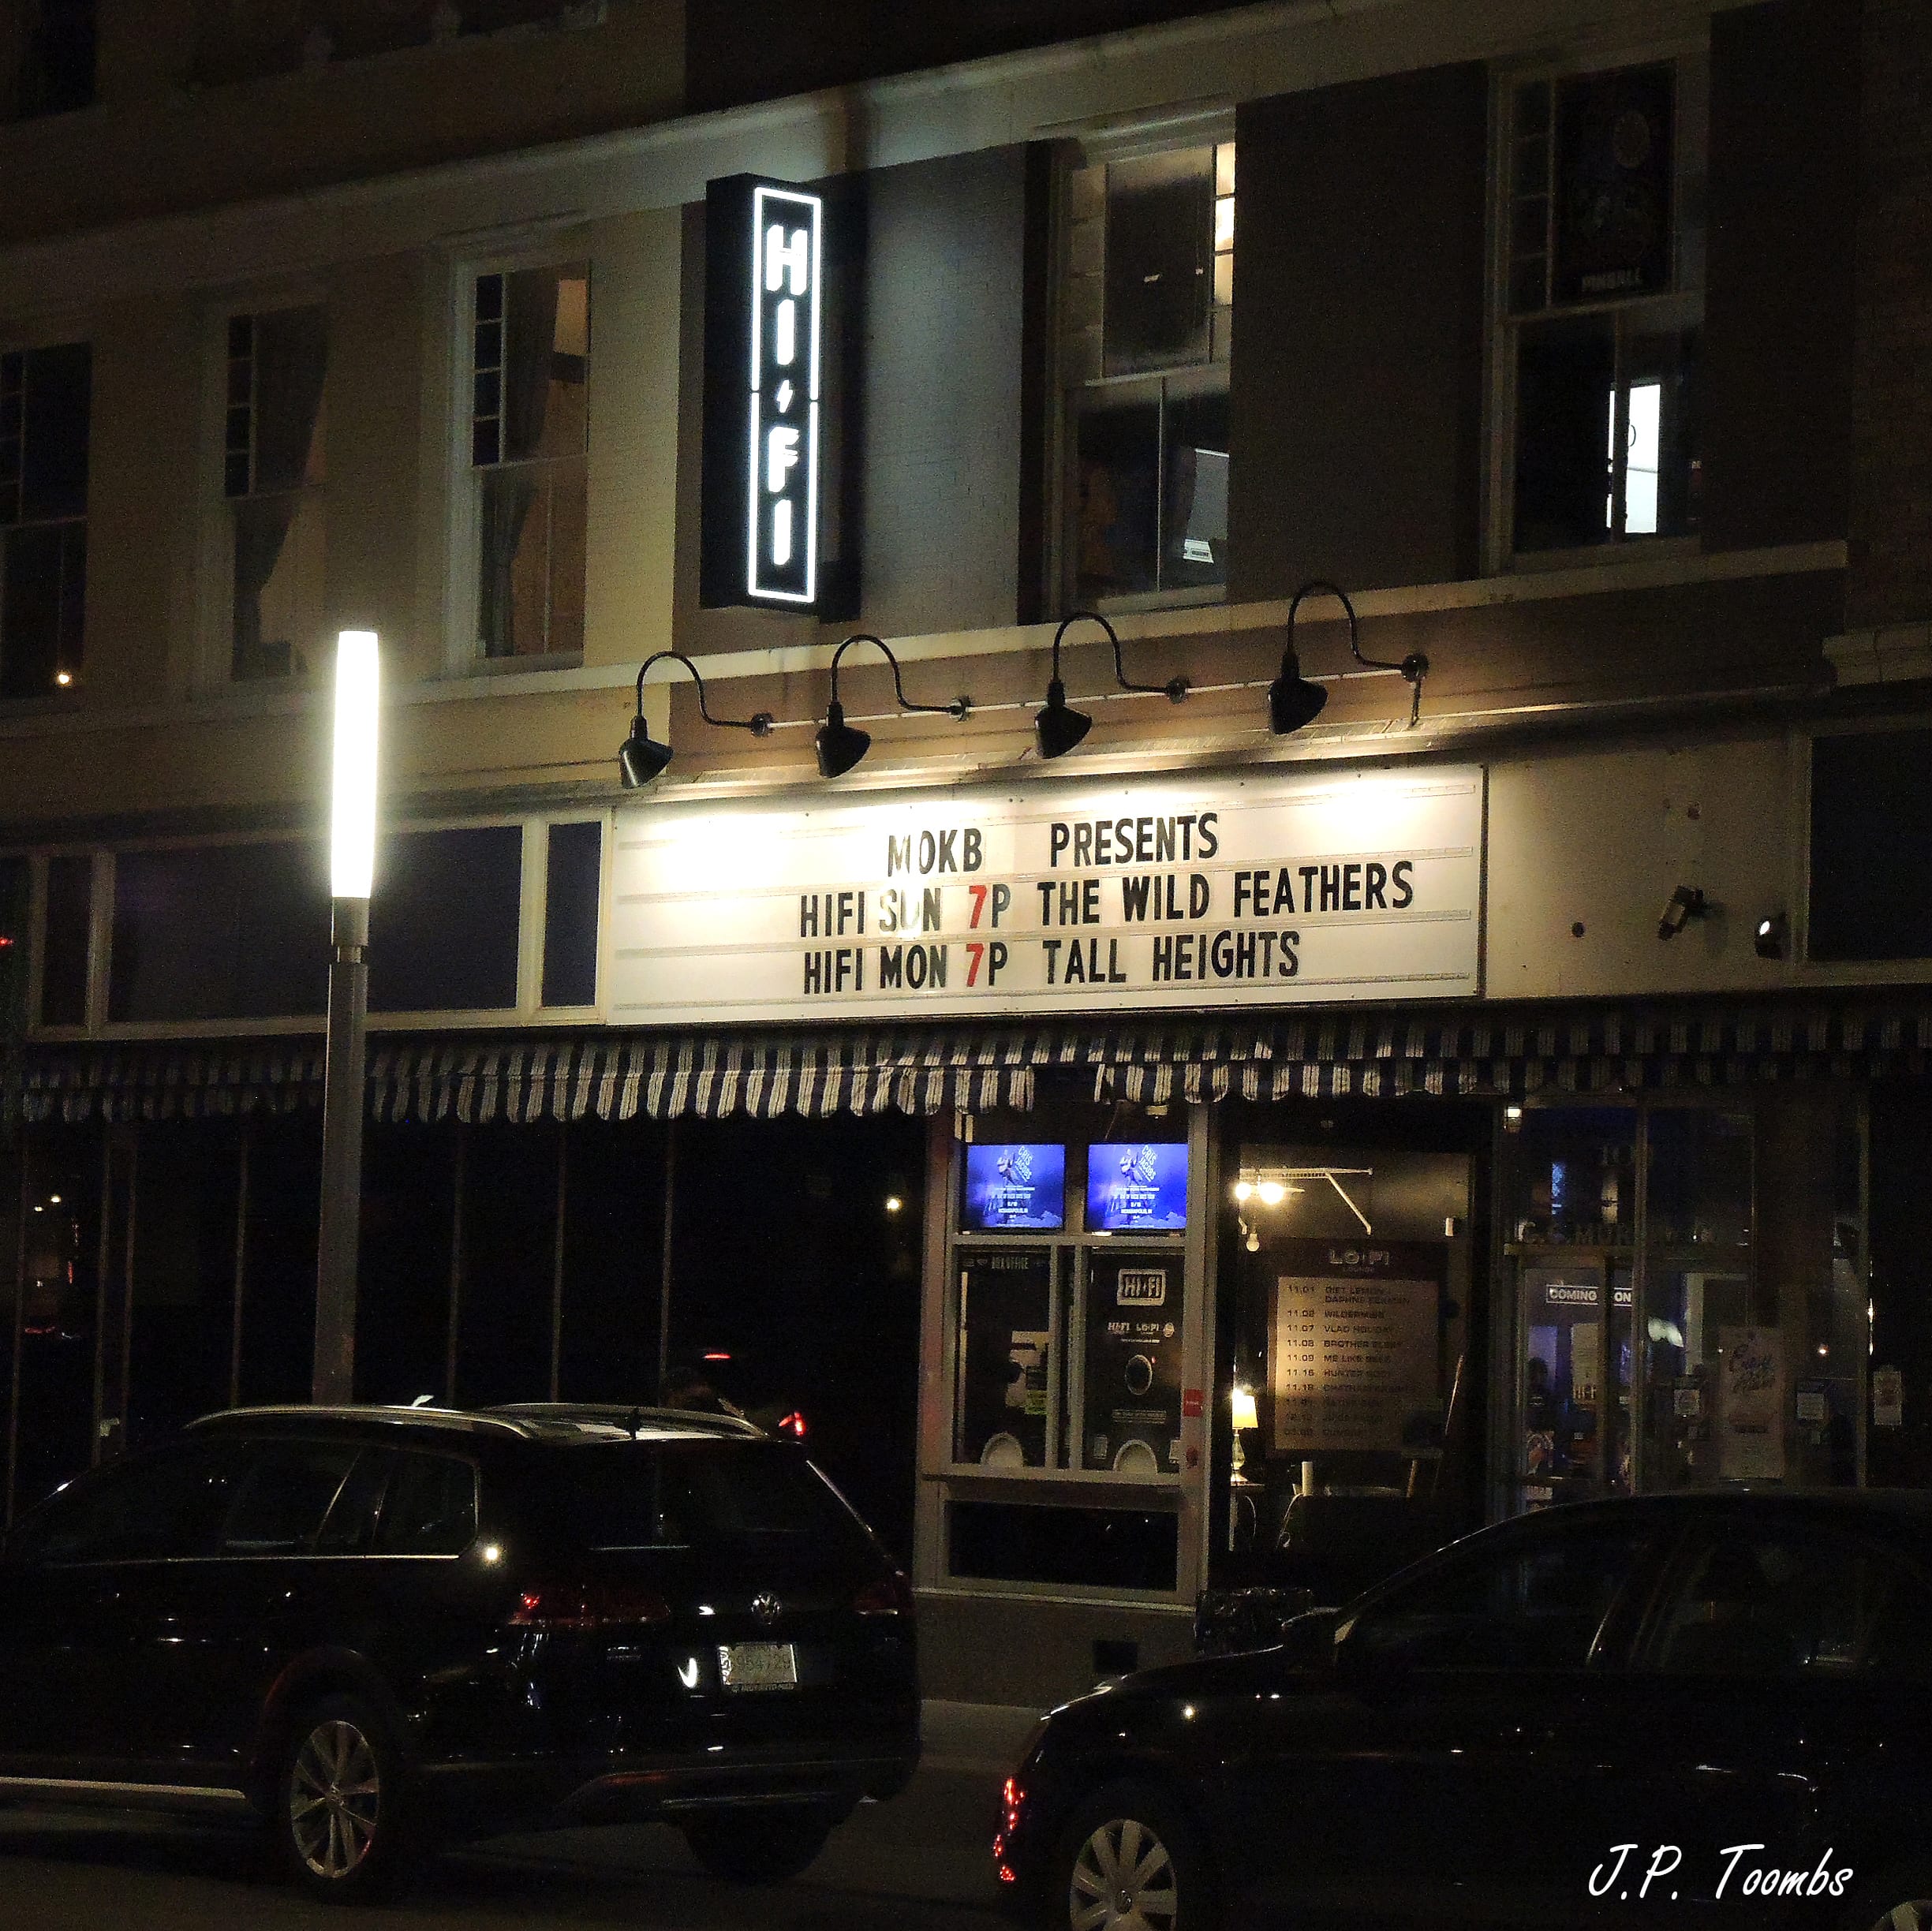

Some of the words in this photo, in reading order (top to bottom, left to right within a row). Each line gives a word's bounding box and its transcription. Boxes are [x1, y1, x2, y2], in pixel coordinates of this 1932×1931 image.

[888, 827, 983, 877] MOKB
[1050, 812, 1219, 868] PRESENTS
[800, 891, 865, 938] HIFI
[879, 887, 942, 932] SUN
[969, 883, 1011, 930] 7P
[1037, 879, 1101, 926] THE
[1122, 872, 1210, 922] WILD
[1234, 861, 1414, 918] FEATHERS
[803, 947, 864, 995] HIFI
[880, 943, 947, 990] MON
[966, 941, 1008, 988] 7P
[1042, 938, 1127, 984] TALL
[1153, 929, 1301, 982] HEIGHTS
[1549, 1287, 1598, 1302] COMING
